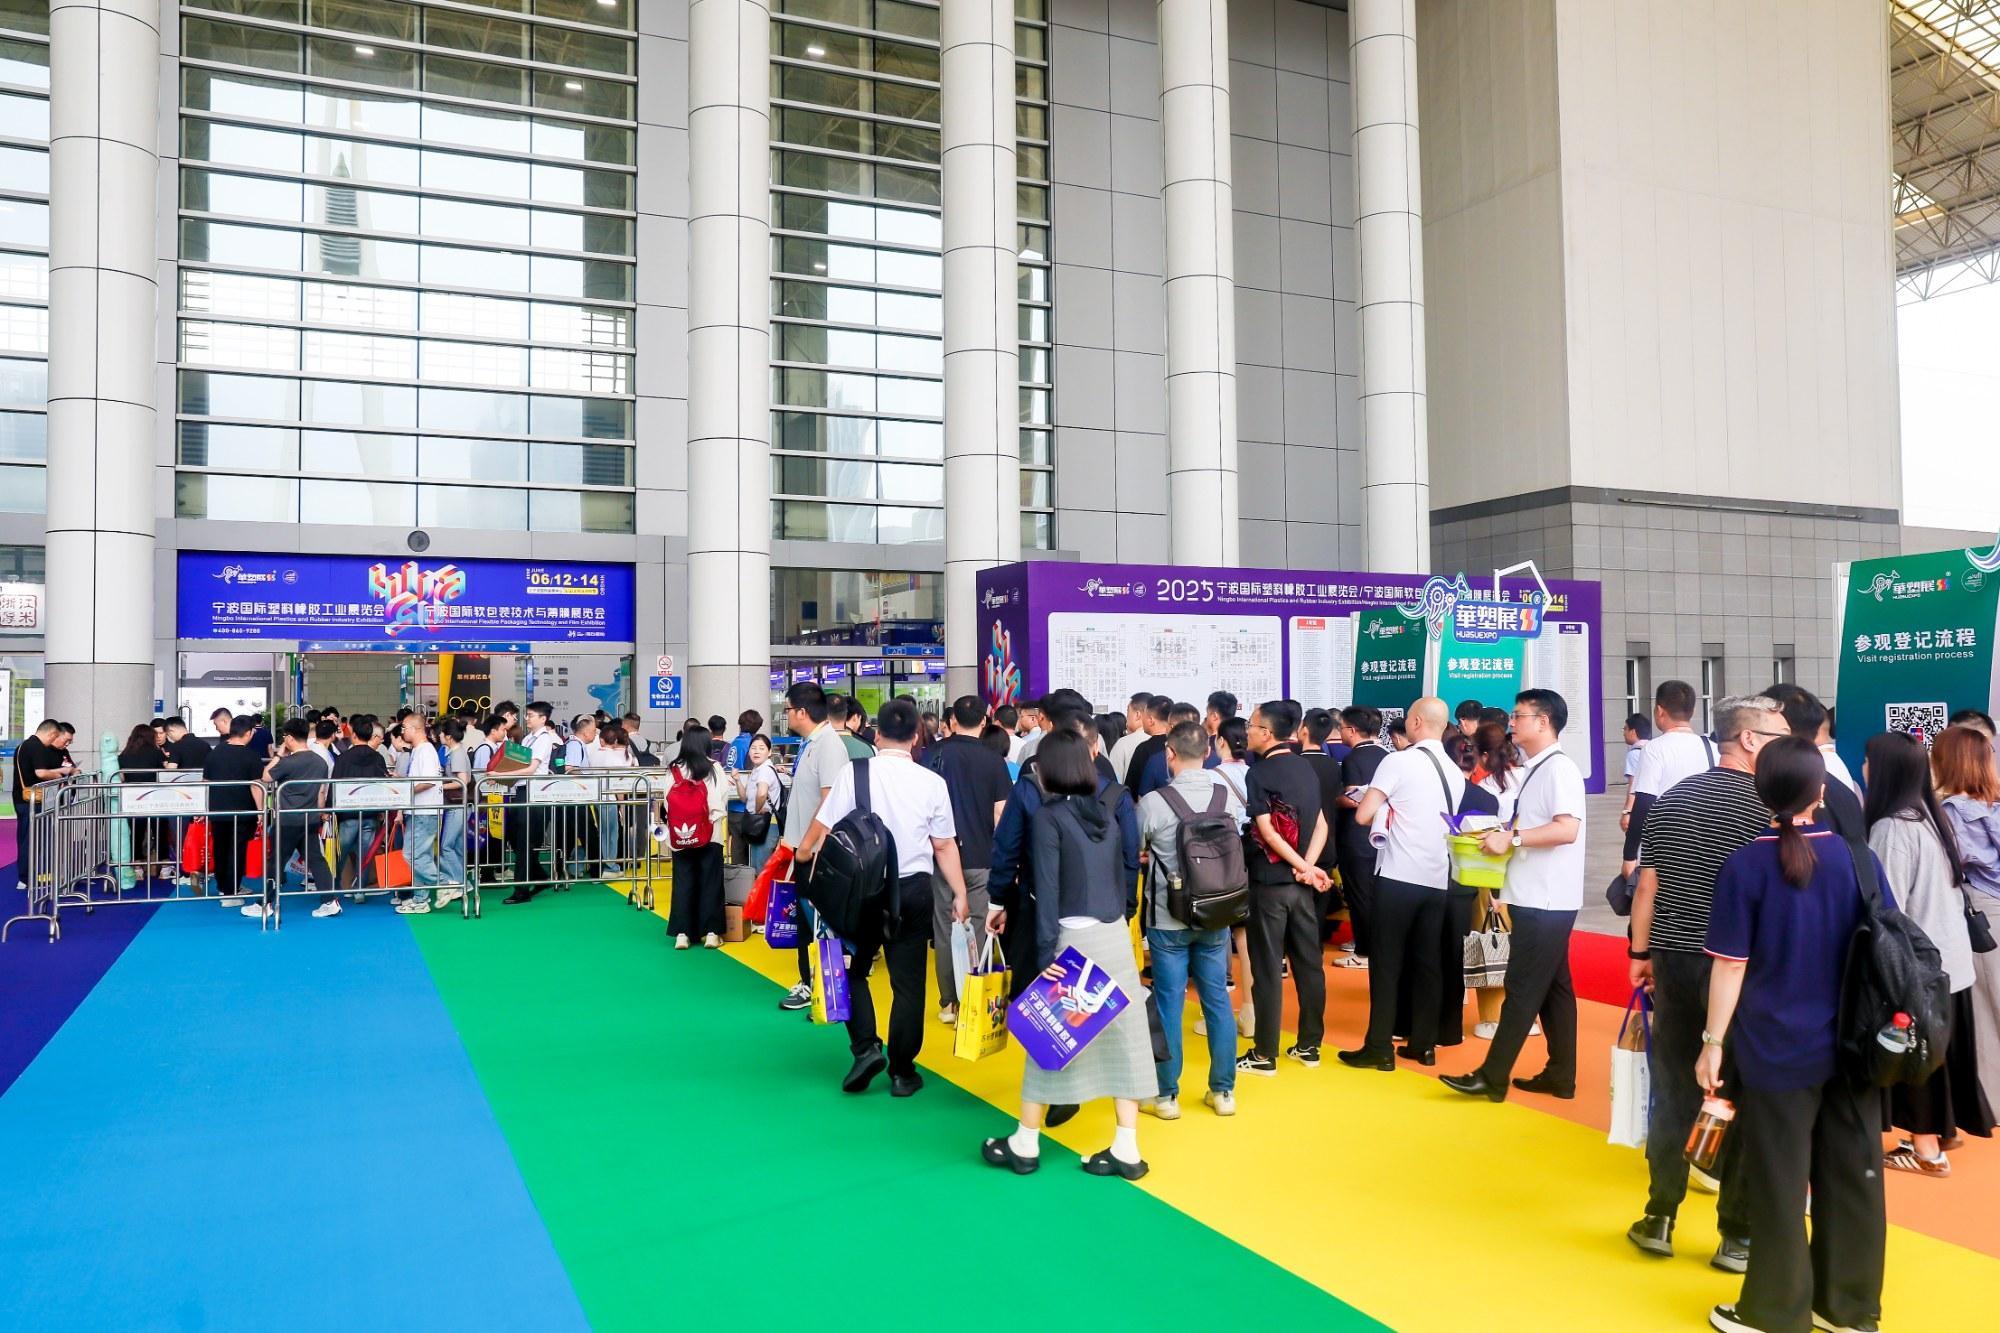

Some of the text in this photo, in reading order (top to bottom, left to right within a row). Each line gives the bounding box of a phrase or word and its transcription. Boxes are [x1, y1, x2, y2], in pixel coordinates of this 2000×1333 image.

[1157, 579, 1214, 602] 2025
[212, 602, 385, 616] 宁波国际塑料橡胶工业展览会
[424, 605, 606, 620] 宁波国际软包装技术与薄膜展览会
[1854, 627, 1977, 653] 参观登记流程
[1857, 649, 1974, 664] Visit registration process
[1361, 658, 1417, 674] 参观登记流程
[1447, 657, 1514, 672] 参观登记流程
[1372, 674, 1397, 682] registration
[1397, 673, 1416, 681] process
[1460, 672, 1491, 680] registration
[675, 837, 699, 846] adidas
